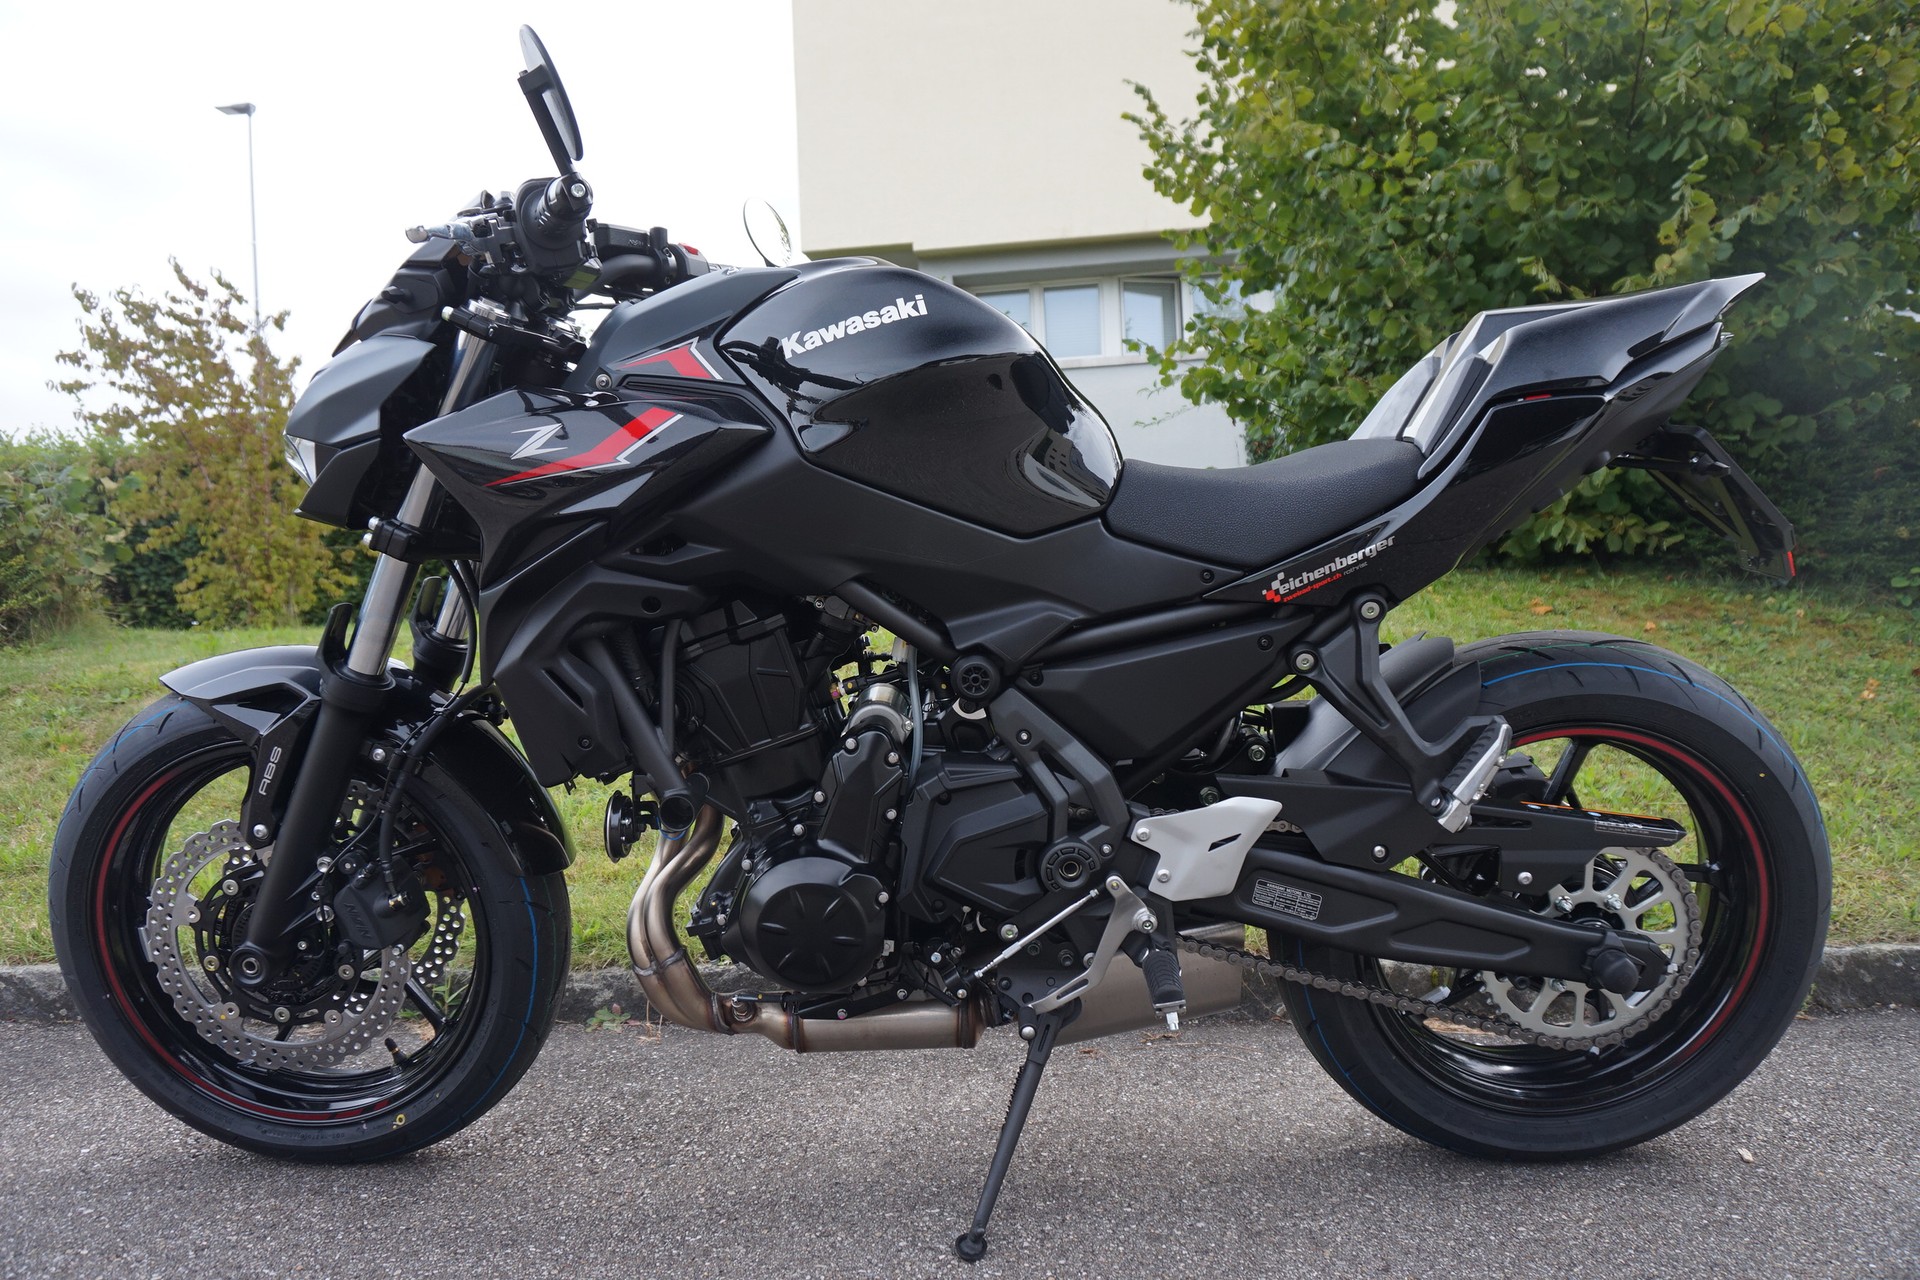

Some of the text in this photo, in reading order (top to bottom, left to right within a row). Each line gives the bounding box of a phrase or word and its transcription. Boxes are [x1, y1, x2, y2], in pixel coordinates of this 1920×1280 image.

[781, 294, 928, 359] Kawasaki
[510, 423, 568, 460] Z
[1279, 535, 1396, 595] eichenberger
[259, 746, 282, 796] ABS
